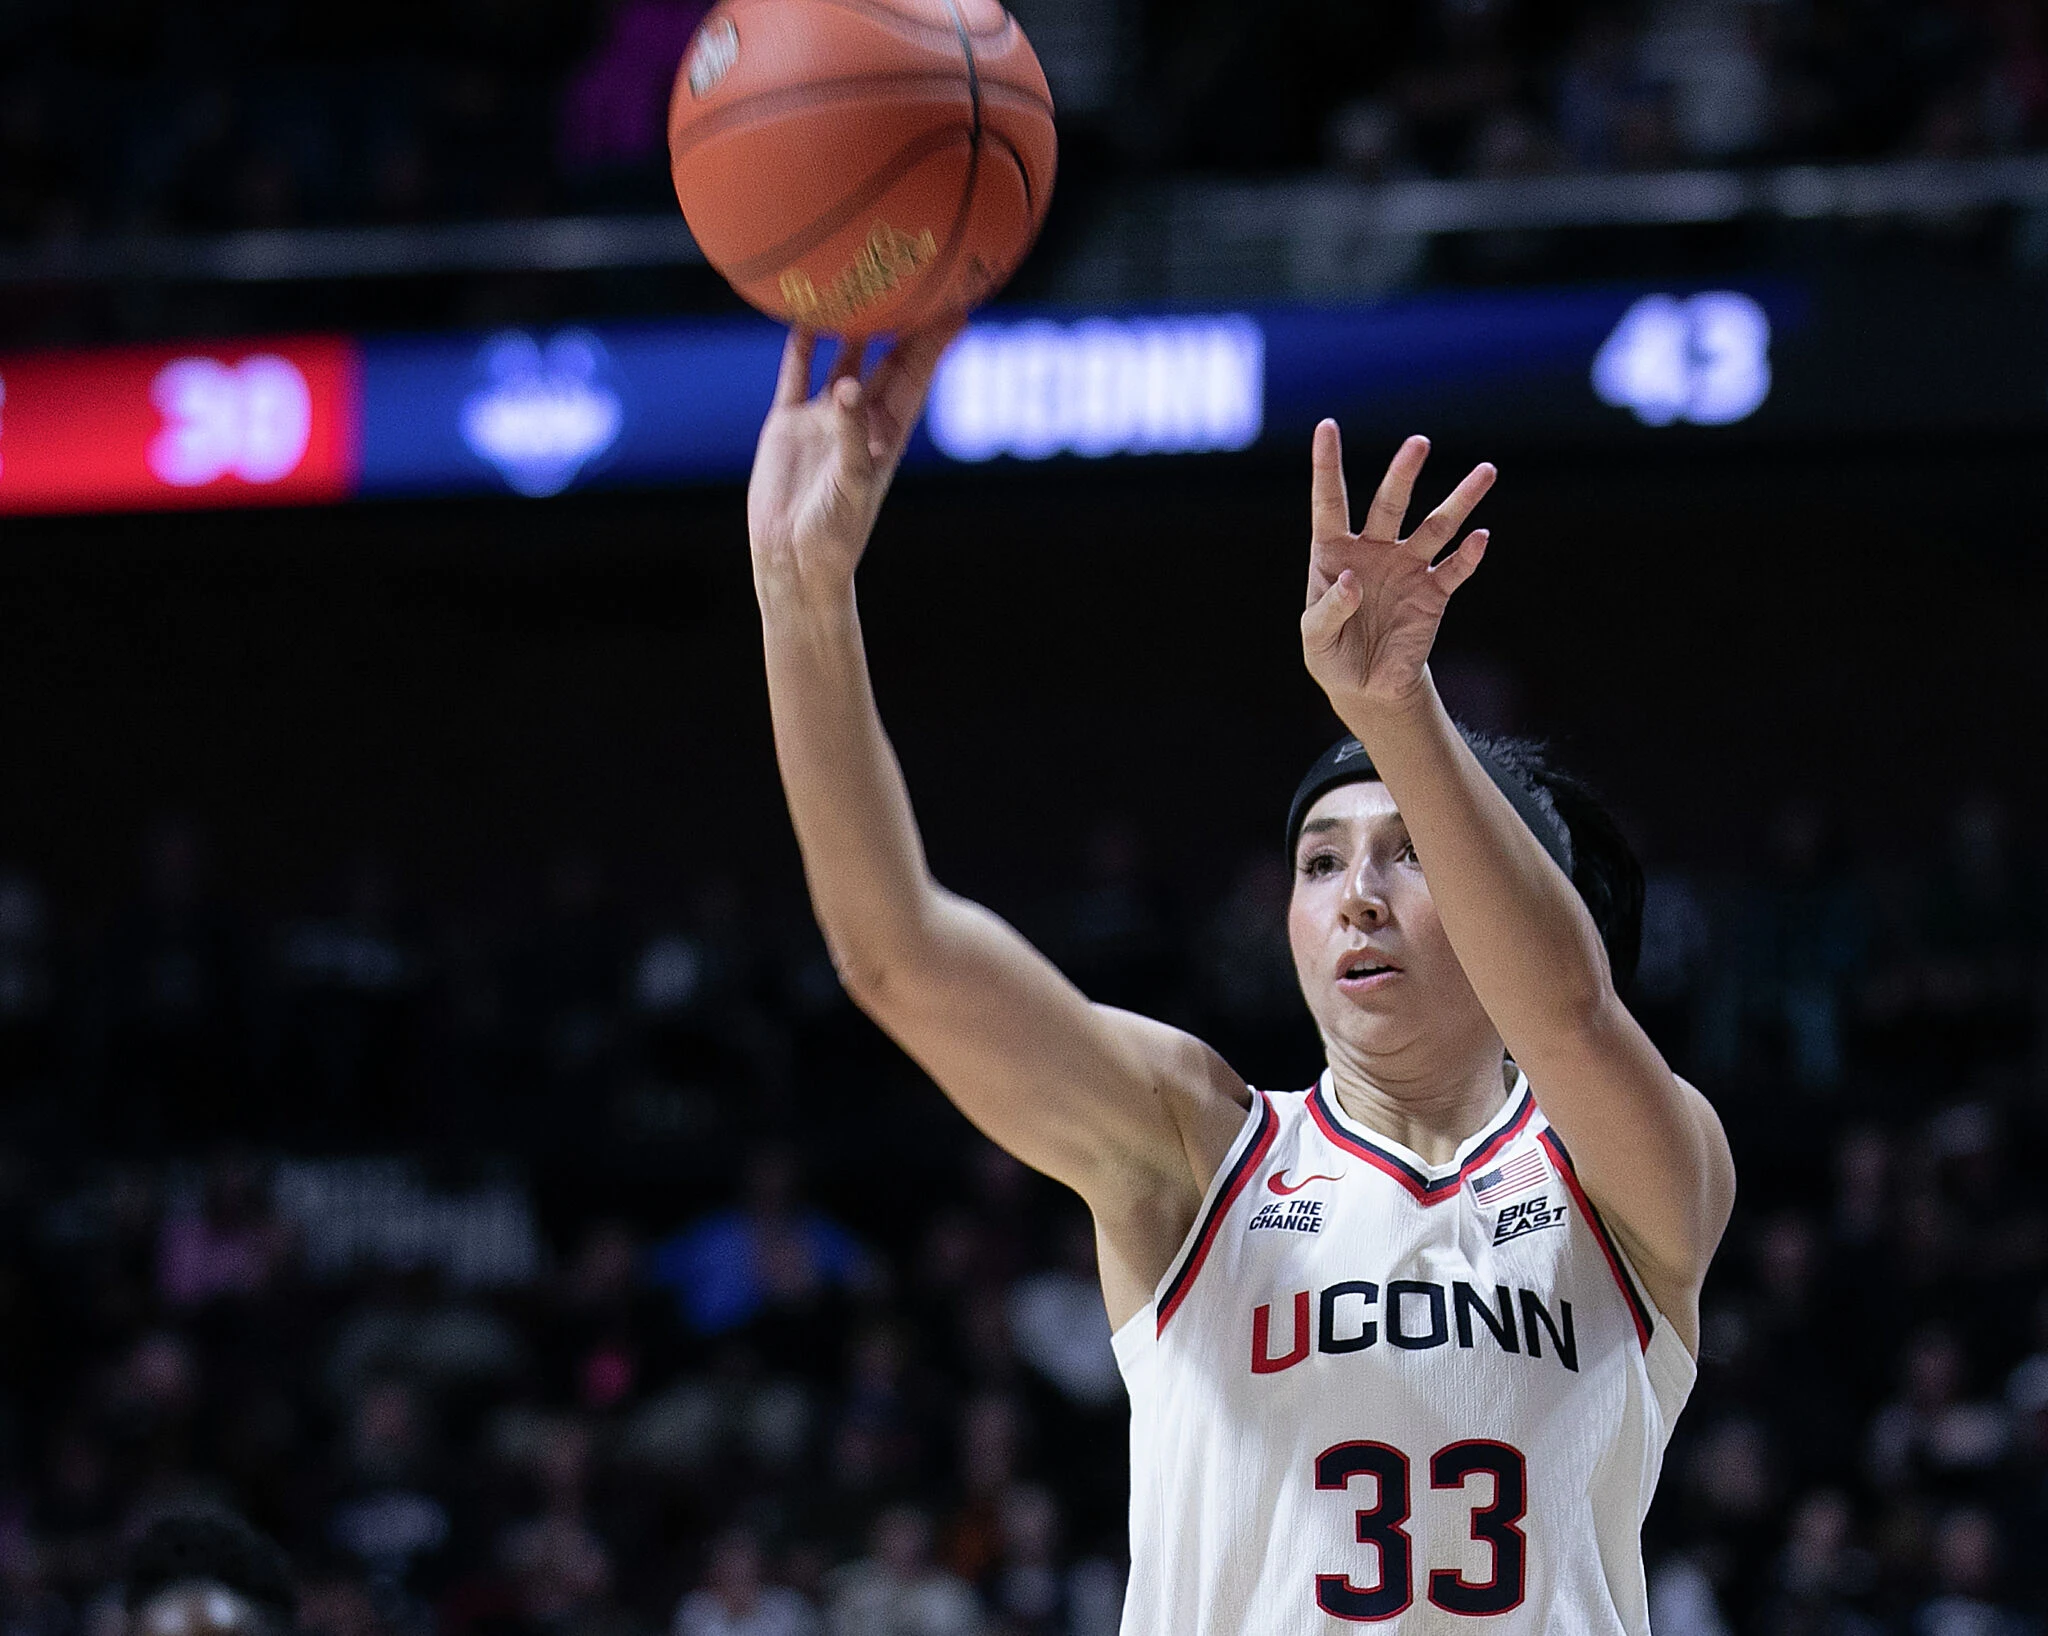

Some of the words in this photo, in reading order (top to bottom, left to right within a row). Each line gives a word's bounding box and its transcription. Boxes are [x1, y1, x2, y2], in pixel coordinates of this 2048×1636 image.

[1593, 292, 1771, 425] 43
[1249, 1215, 1323, 1233] CHANGE
[1259, 1202, 1284, 1215] BE
[1289, 1201, 1323, 1215] THE
[1494, 1206, 1567, 1239] EAST
[1498, 1196, 1548, 1224] BIG
[1251, 1280, 1579, 1374] UCONN
[1315, 1438, 1527, 1622] 33
